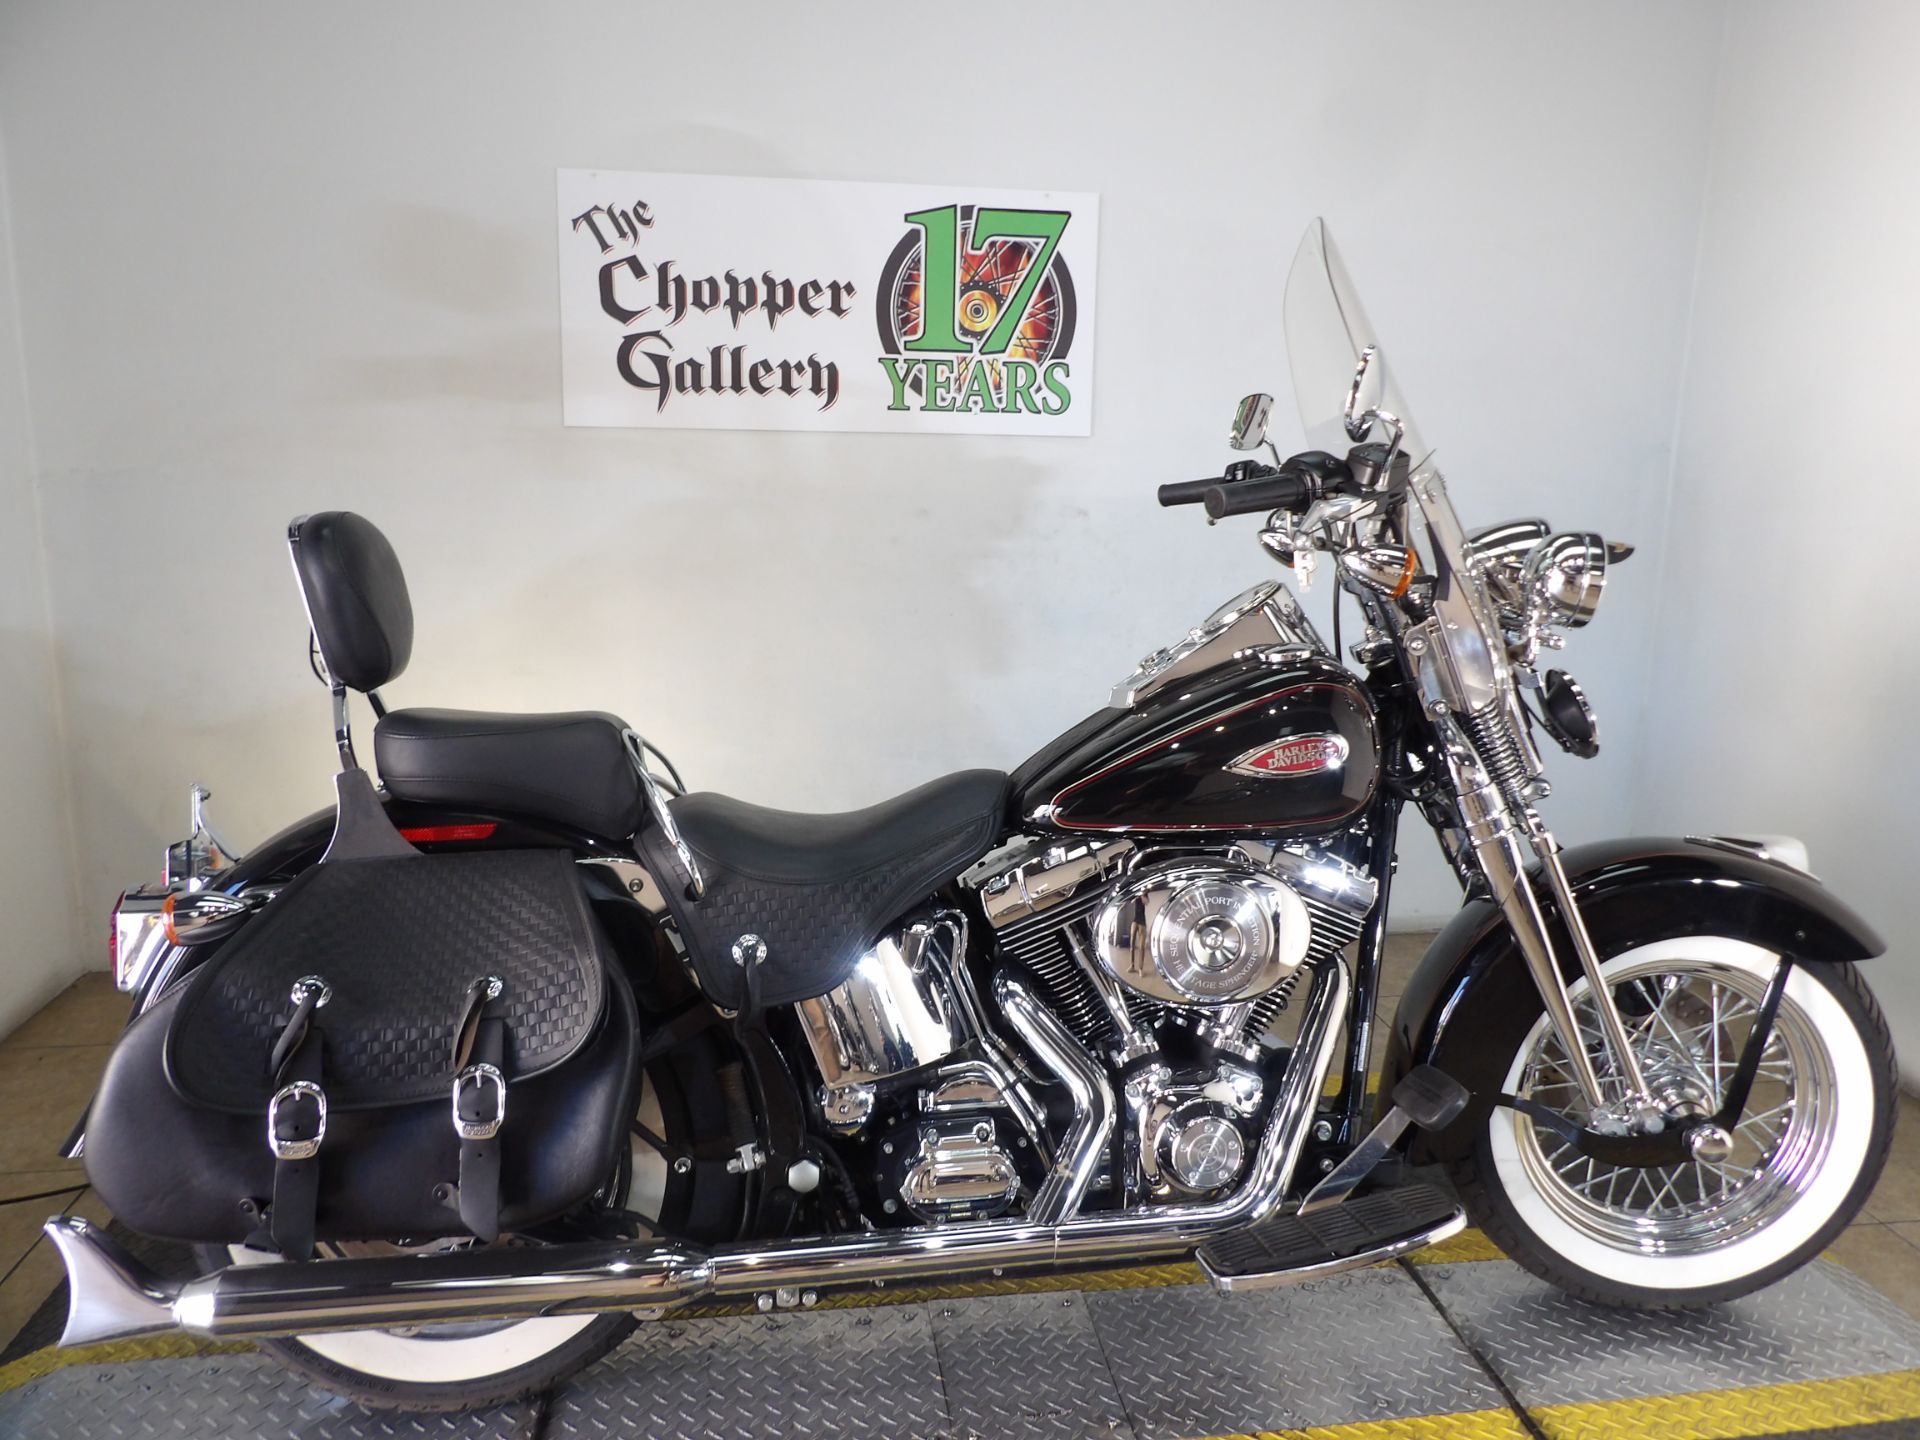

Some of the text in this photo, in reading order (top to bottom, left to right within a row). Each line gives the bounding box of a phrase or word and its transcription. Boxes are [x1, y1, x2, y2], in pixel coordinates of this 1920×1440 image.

[571, 200, 655, 254] The
[599, 255, 857, 331] Chopper
[904, 204, 1072, 354] 17
[616, 330, 840, 413] Gallery
[879, 358, 1071, 415] YEARS
[1204, 896, 1233, 906] PORT
